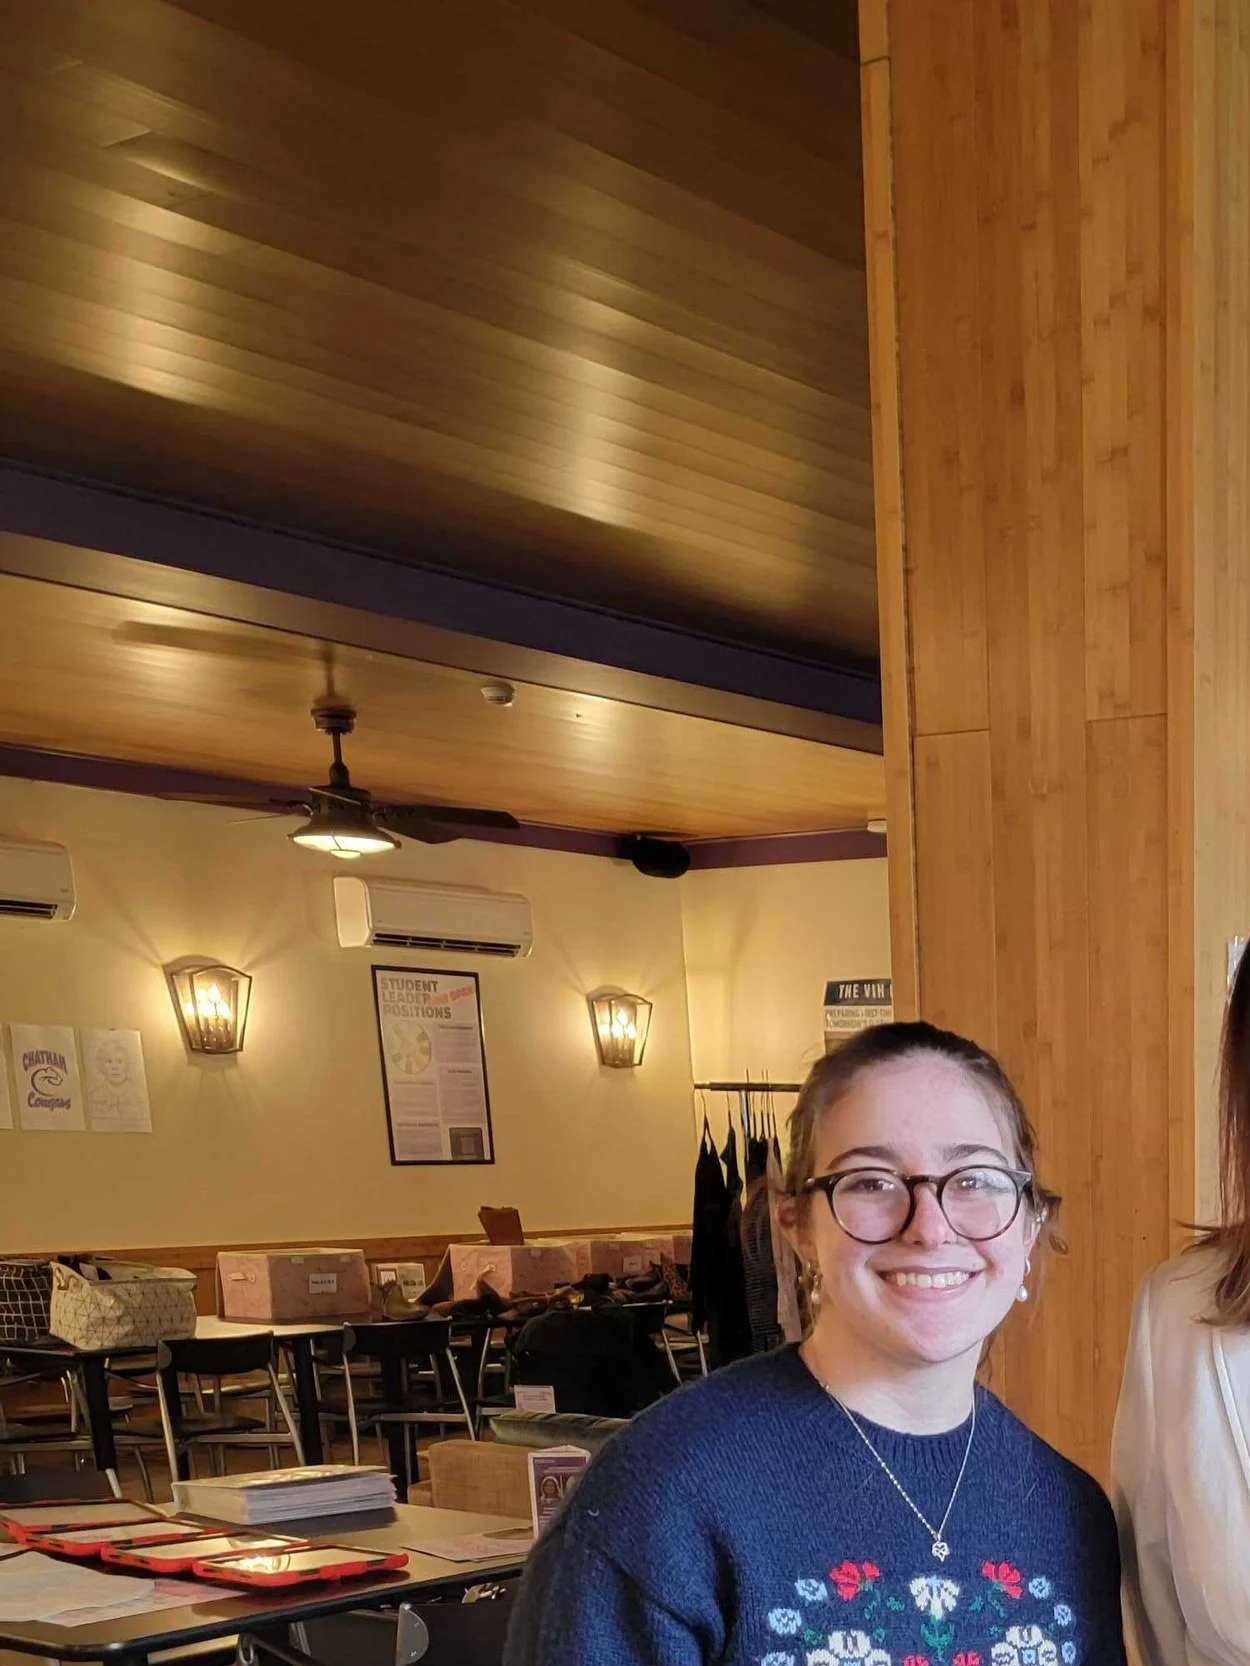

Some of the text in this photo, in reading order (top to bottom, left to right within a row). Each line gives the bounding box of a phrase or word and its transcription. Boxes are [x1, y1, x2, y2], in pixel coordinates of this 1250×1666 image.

[380, 977, 439, 992] STUDENT
[839, 983, 860, 999] THE
[383, 1004, 452, 1019] POSITIONS
[22, 1050, 69, 1076] CHATHAM
[27, 1090, 72, 1111] Cougars
